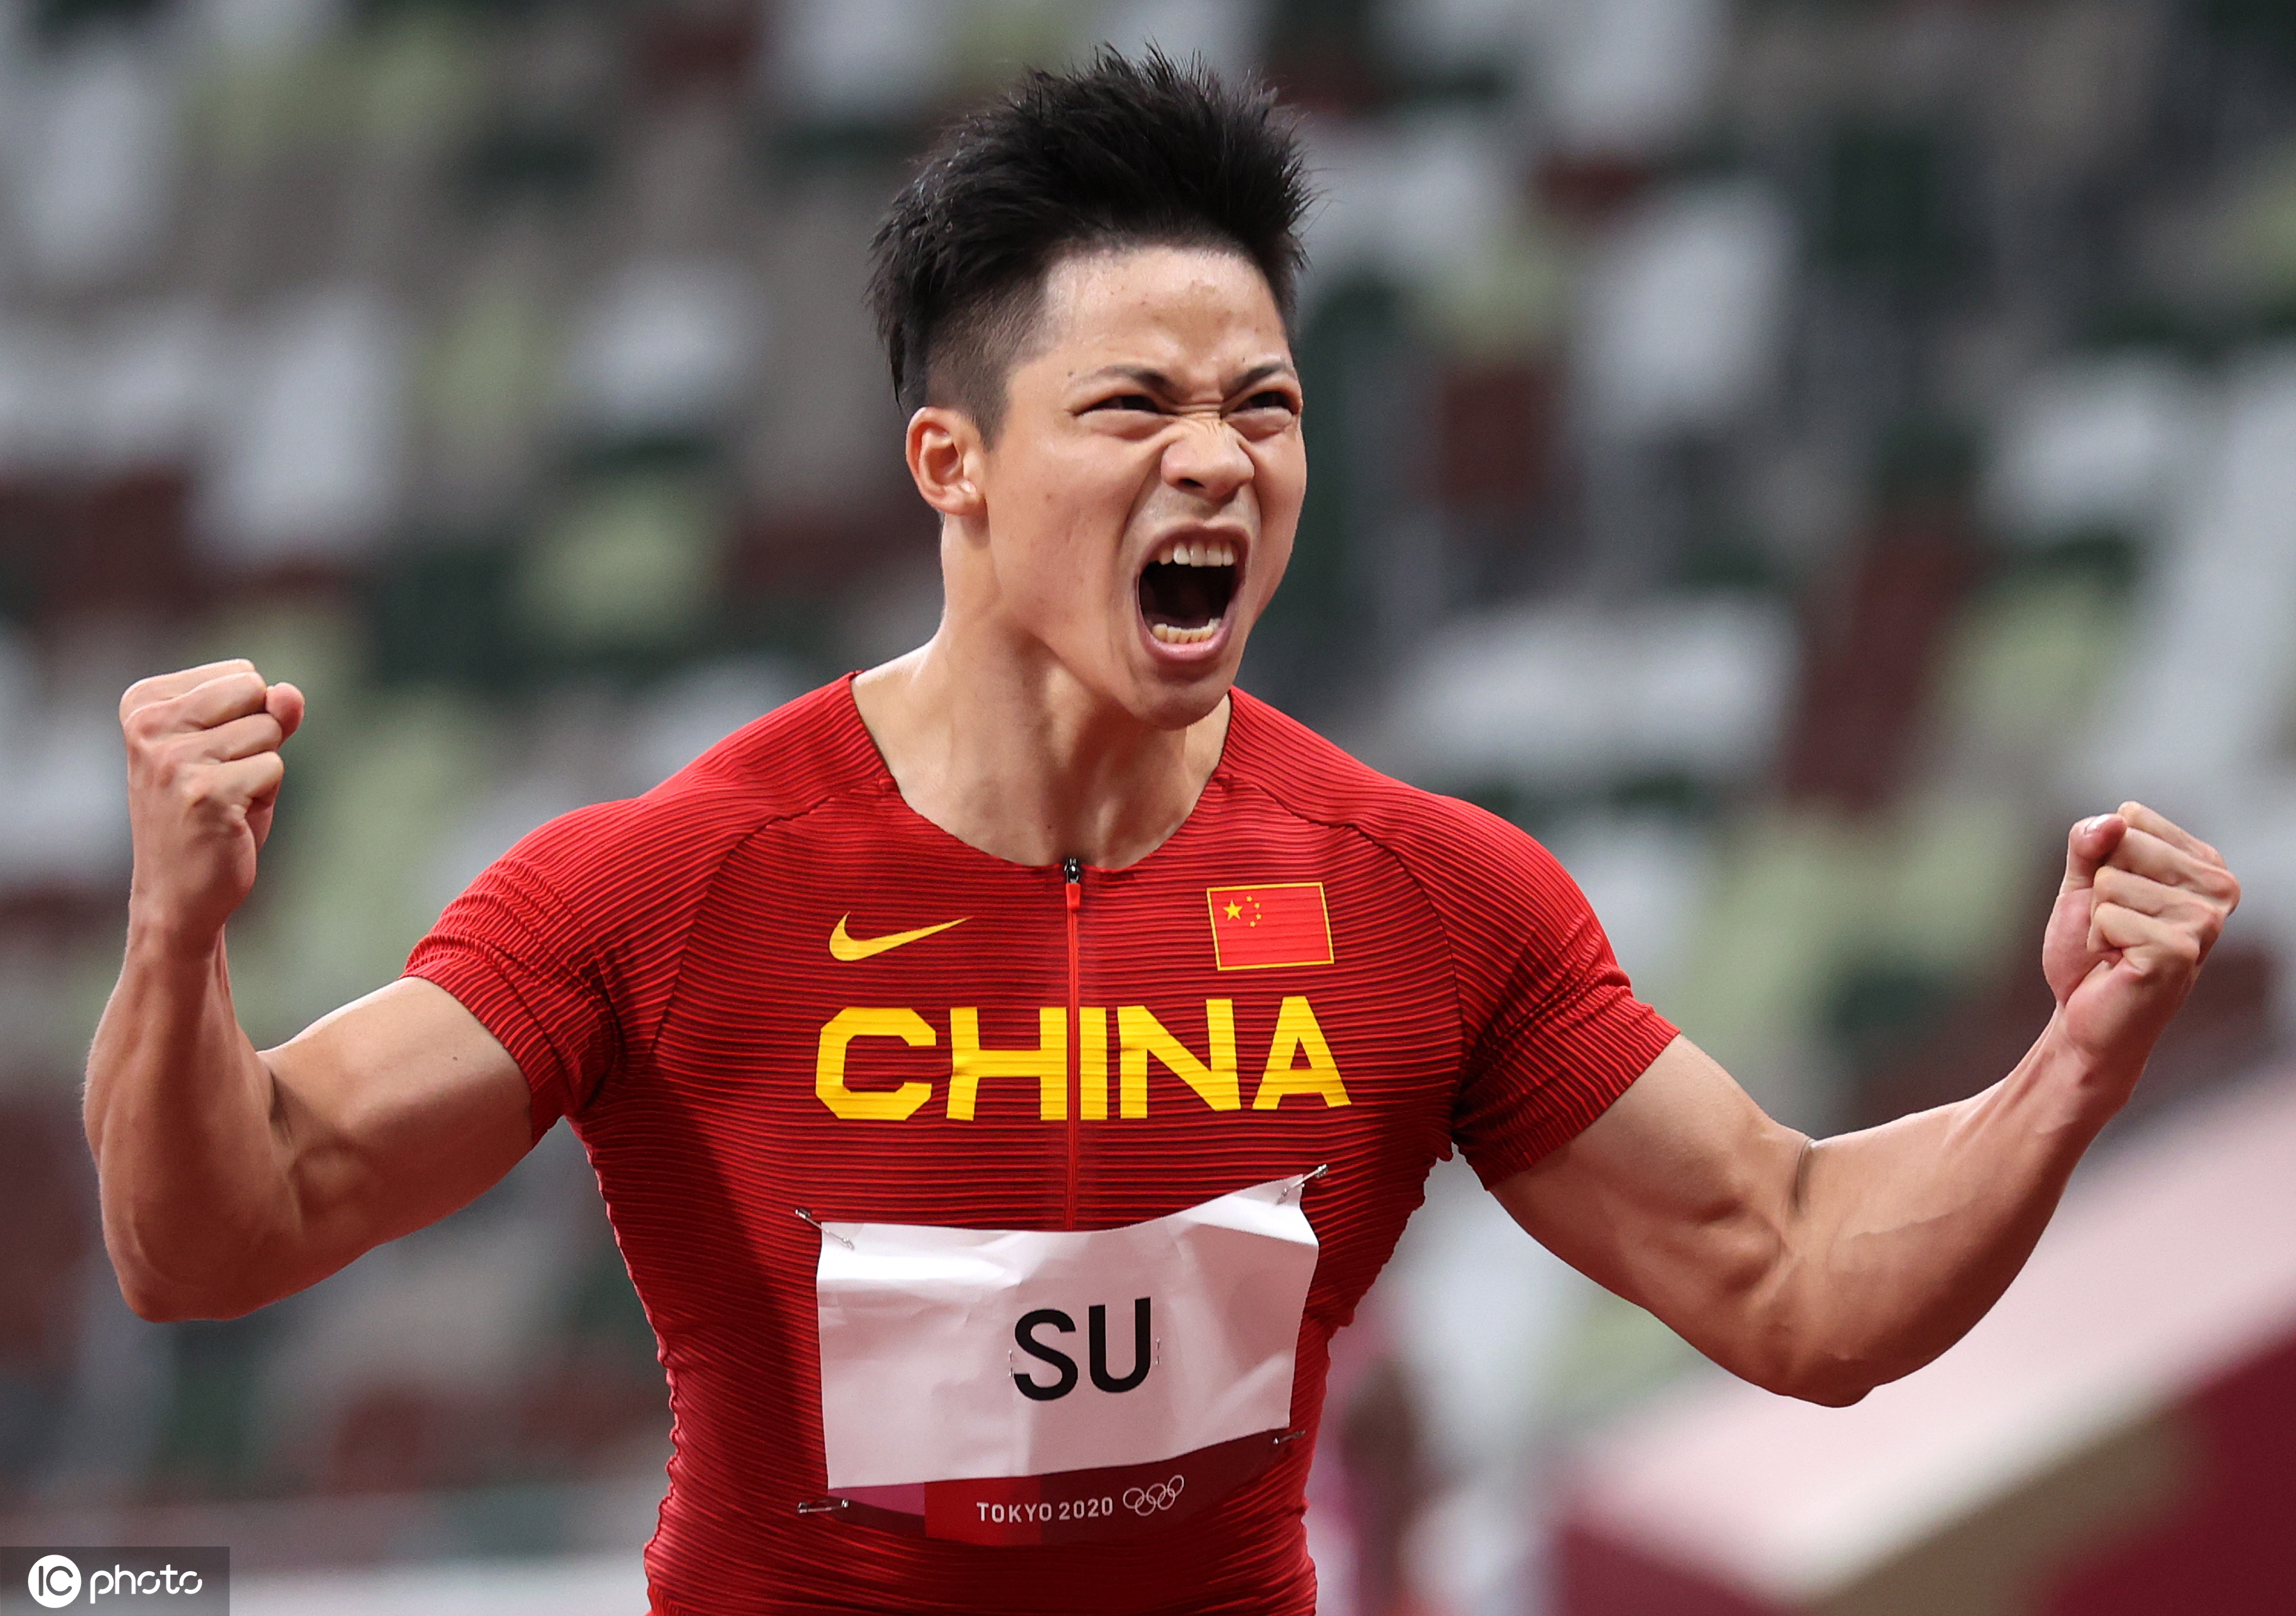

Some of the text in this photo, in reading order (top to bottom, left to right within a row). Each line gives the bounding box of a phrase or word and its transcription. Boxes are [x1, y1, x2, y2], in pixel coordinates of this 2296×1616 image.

[815, 996, 1351, 1121] CHINA
[1013, 1297, 1151, 1401] SU
[977, 1497, 1114, 1524] TOKYO 2020
